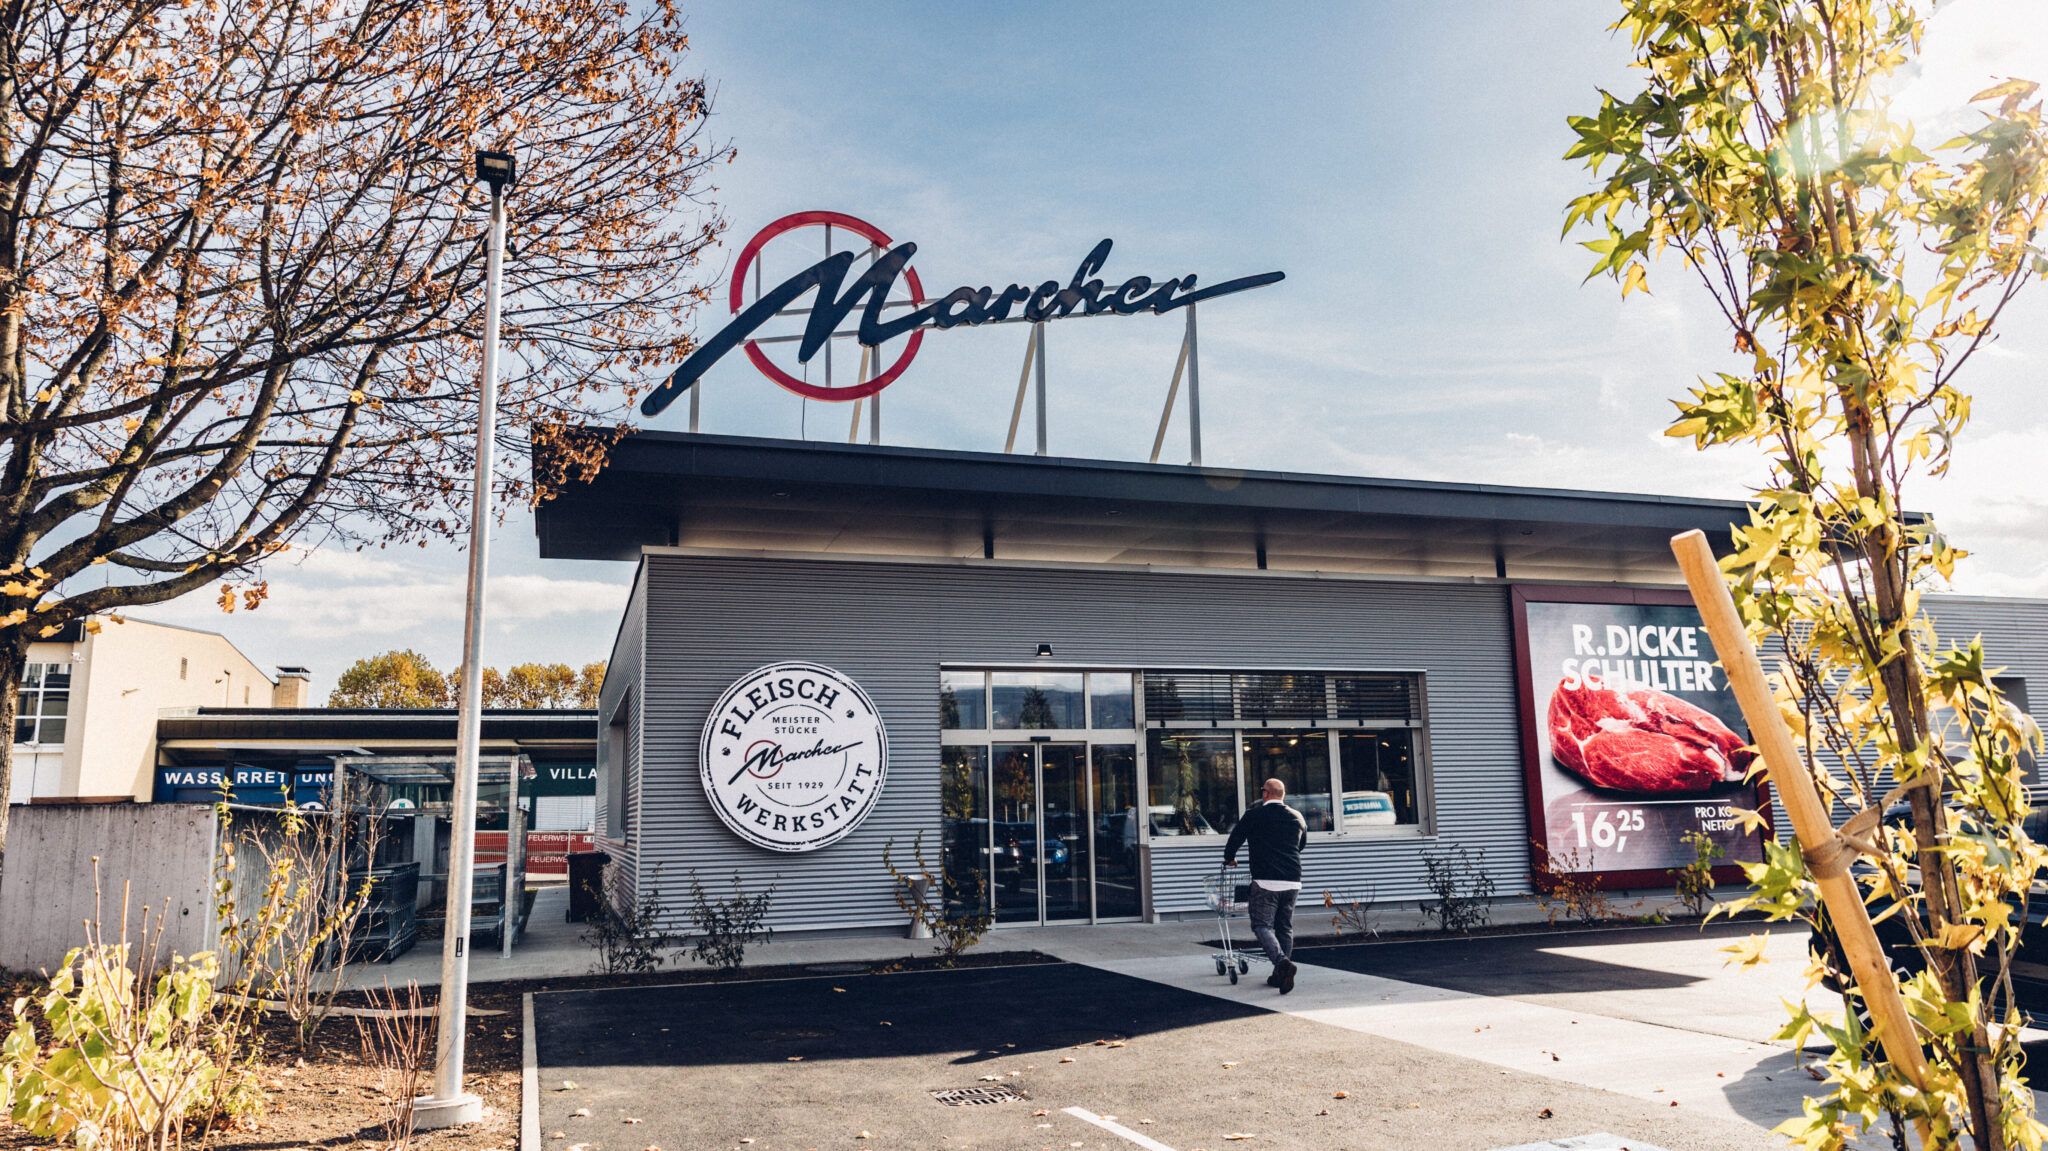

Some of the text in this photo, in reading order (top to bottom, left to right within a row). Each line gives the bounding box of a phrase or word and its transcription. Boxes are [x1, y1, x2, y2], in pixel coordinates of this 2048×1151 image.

[641, 238, 1285, 417] Marcher
[1562, 659, 1717, 692] SCHULTER
[720, 678, 840, 740] FLEISCH
[772, 716, 820, 724] MEISTER
[774, 725, 818, 734] STÜCKE
[728, 738, 863, 785] Marcher
[768, 781, 824, 790] SEIT 1929
[736, 763, 872, 832] WERKSTATT
[1694, 806, 1716, 818] PRO
[1702, 820, 1735, 831] NETTO
